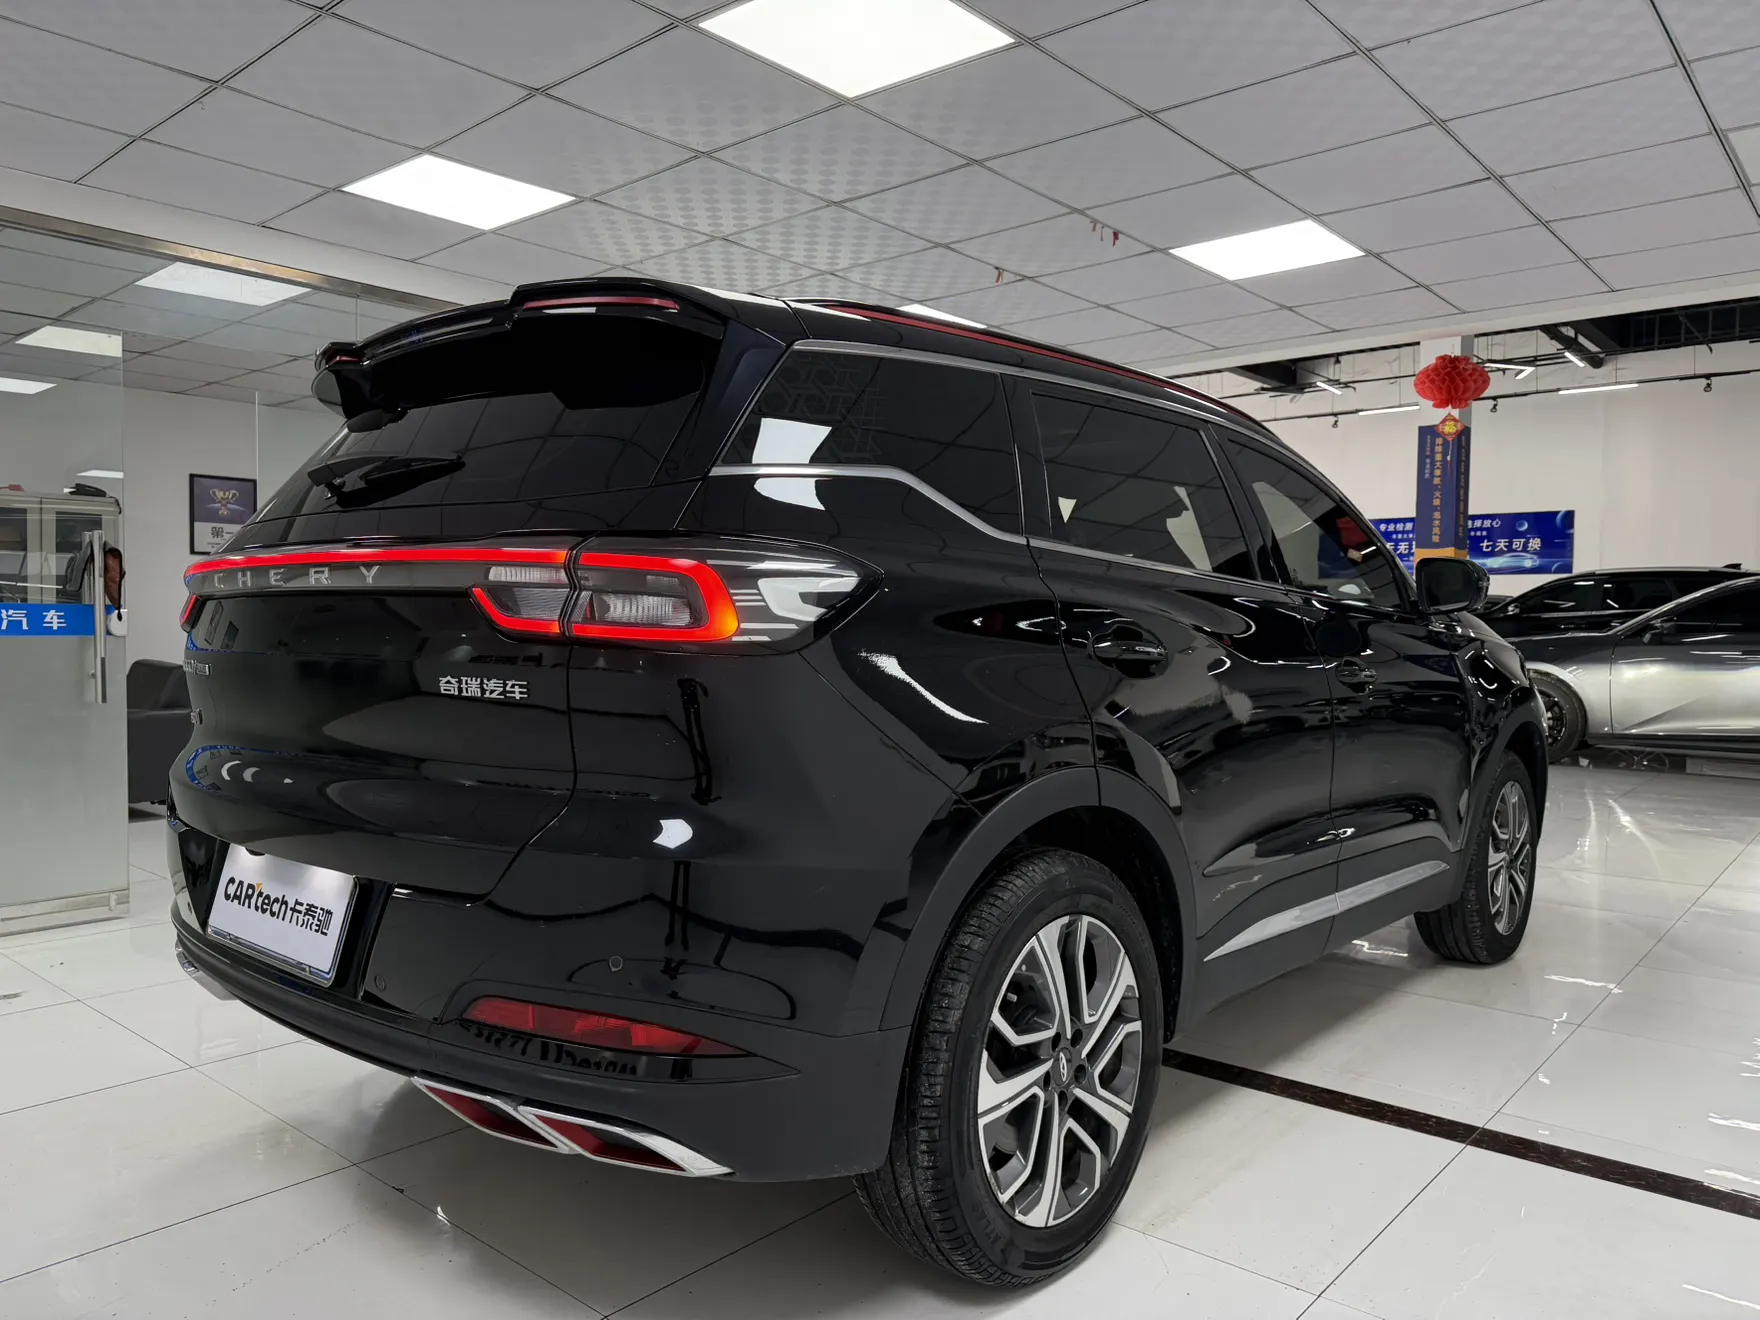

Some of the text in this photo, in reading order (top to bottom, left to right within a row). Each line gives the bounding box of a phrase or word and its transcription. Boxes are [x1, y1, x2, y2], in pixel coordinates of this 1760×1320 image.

[1479, 537, 1542, 552] 七天可换
[213, 565, 380, 589] CHERY
[0, 608, 67, 630] 汽车
[438, 675, 528, 700] 奇瑞汽车
[289, 898, 334, 936] 卡泰驰
